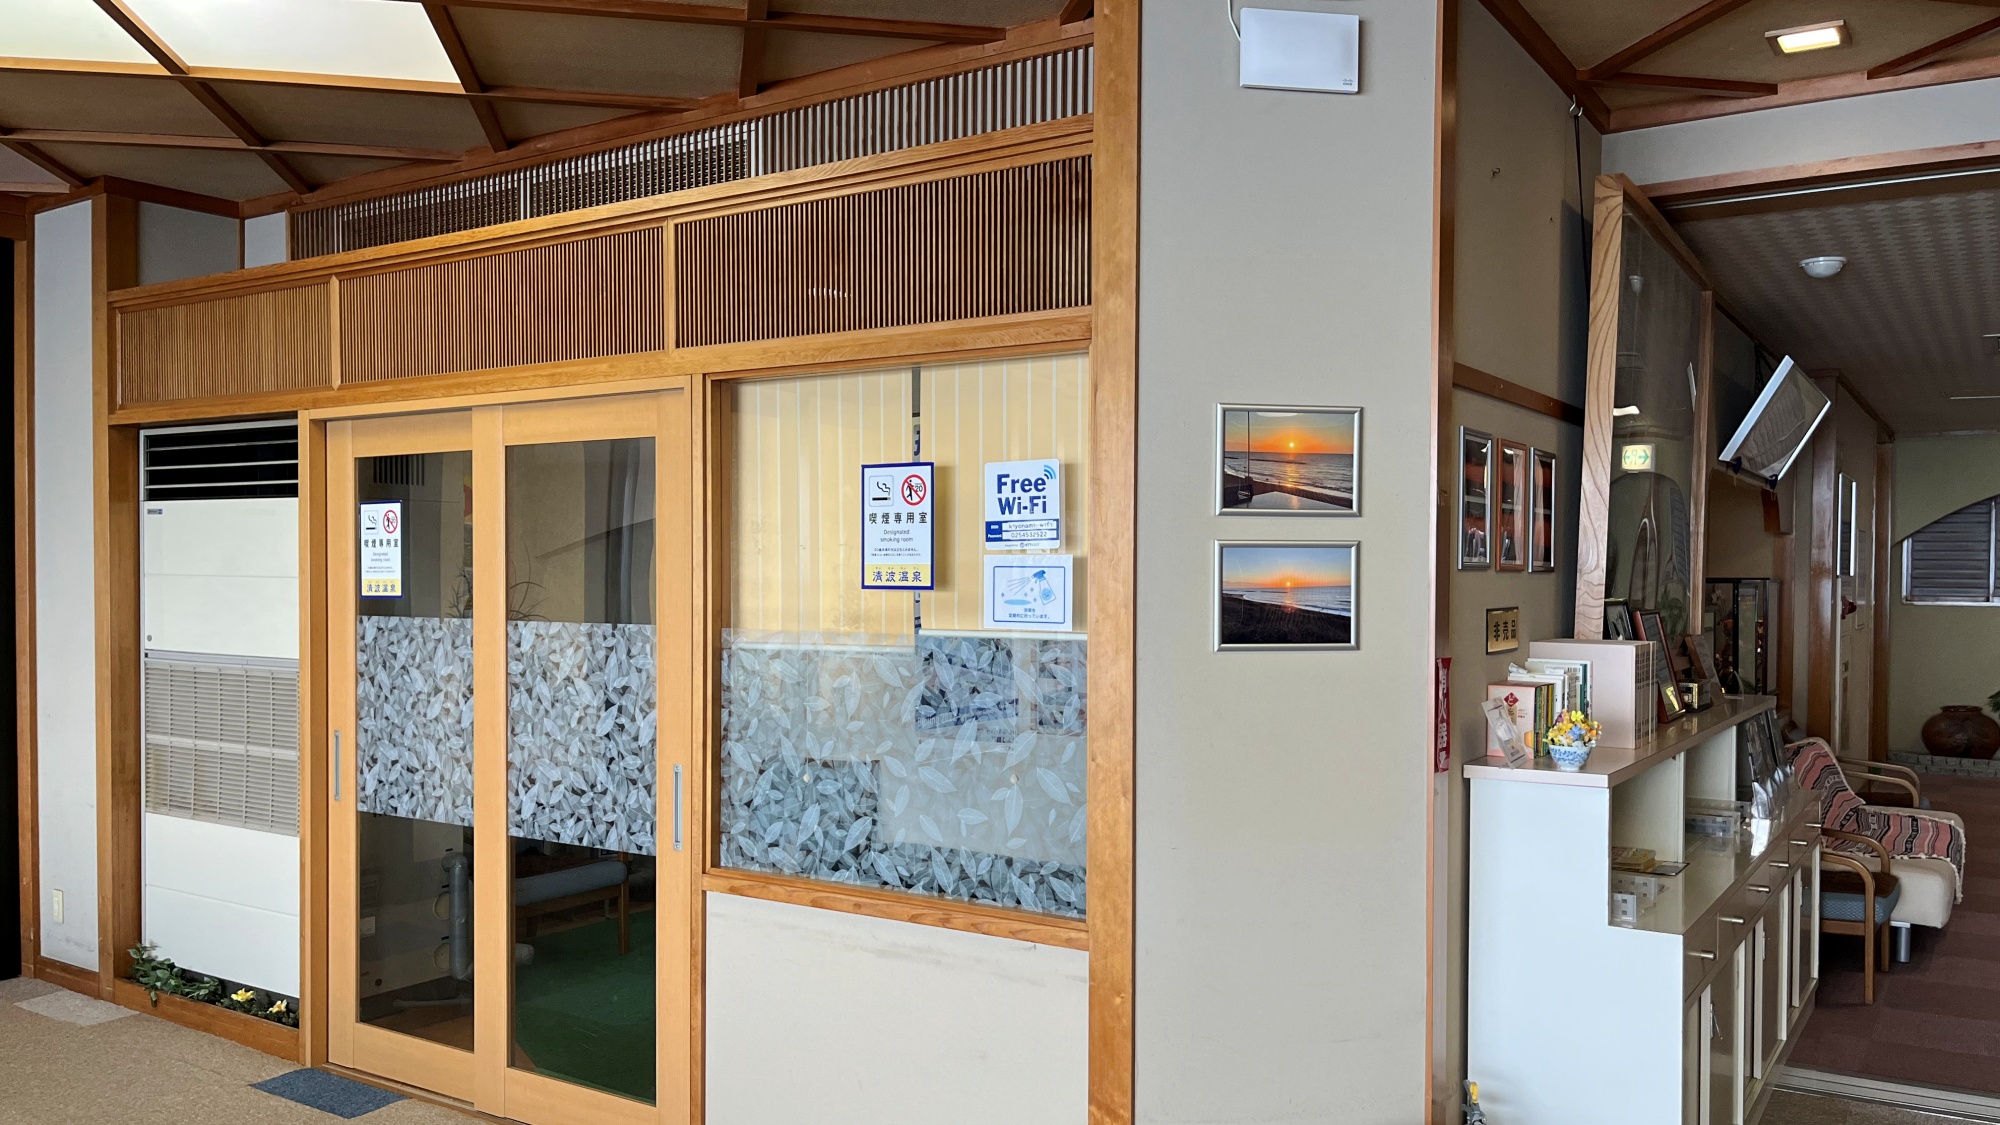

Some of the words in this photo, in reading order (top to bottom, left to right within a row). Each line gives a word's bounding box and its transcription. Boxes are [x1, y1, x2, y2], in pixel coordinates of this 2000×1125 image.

[997, 473, 1046, 494] Free
[997, 495, 1047, 515] Wi-Fi
[869, 512, 928, 525] 喫煙専用室
[872, 570, 922, 583] 清波温泉
[1493, 619, 1517, 642] 非売品
